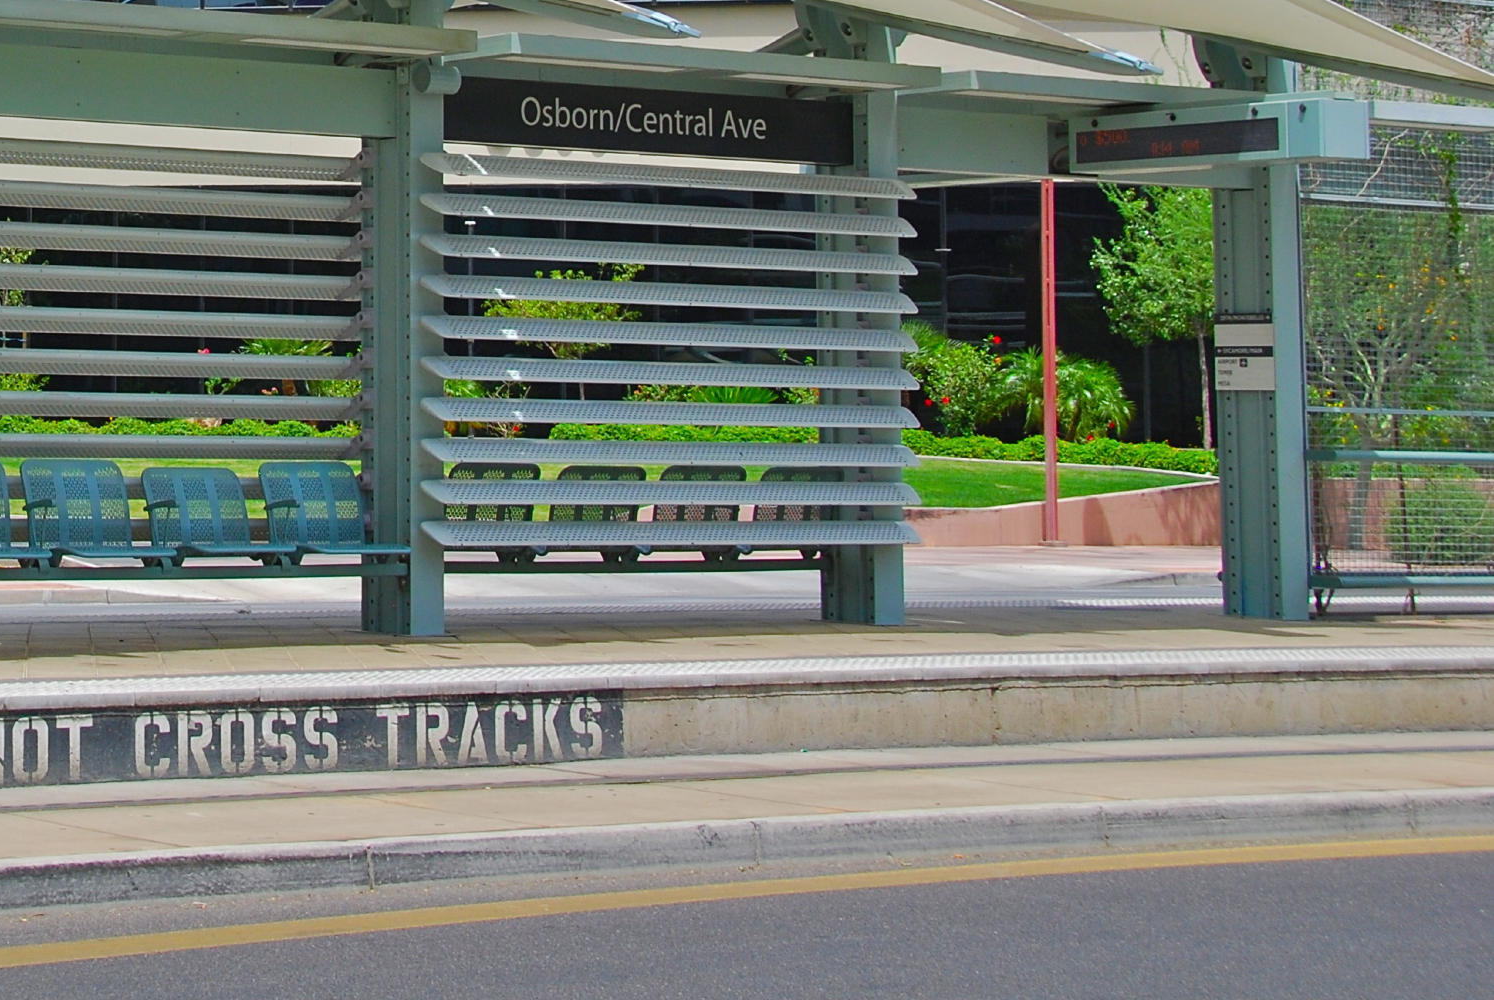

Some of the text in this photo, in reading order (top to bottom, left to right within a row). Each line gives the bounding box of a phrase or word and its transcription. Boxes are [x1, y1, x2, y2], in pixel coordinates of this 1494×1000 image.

[520, 96, 767, 140] Osborn/Central Ave
[134, 705, 339, 779] CROSS
[376, 696, 603, 768] TRACKS
